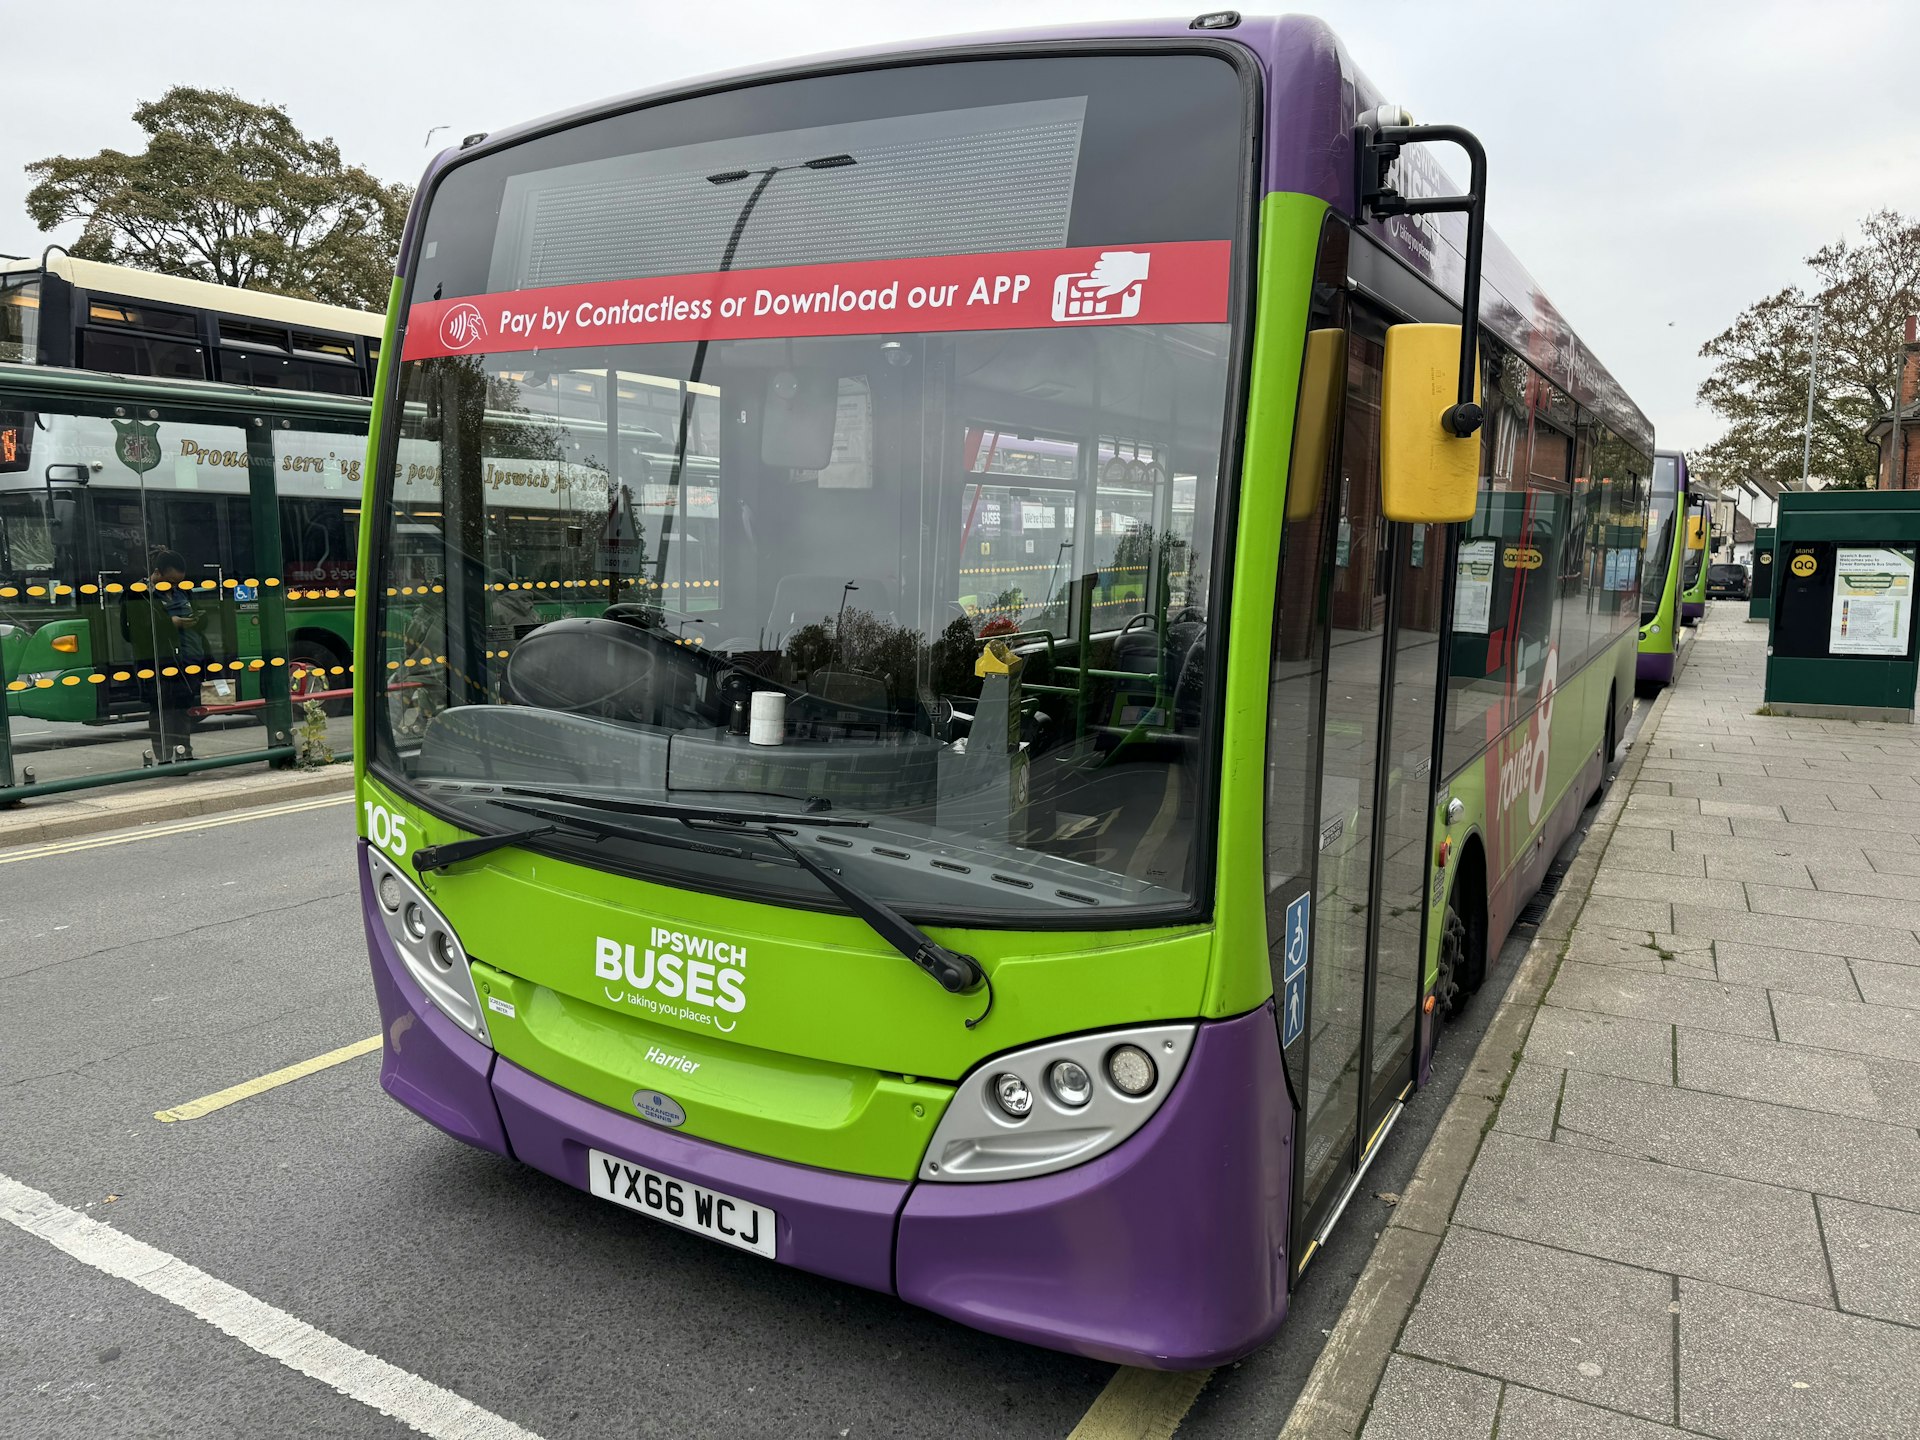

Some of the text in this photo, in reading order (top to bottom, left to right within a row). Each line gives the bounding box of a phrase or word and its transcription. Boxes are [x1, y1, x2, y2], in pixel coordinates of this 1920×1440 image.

[500, 274, 1031, 337] Pay by Contactless or Download our APP
[180, 438, 249, 469] Prou
[485, 463, 549, 490] Ipswich
[1794, 560, 1814, 570] QQ
[1496, 733, 1532, 821] route
[1528, 648, 1558, 826] 8
[364, 800, 407, 856] 105
[651, 927, 747, 968] IPSWICH
[595, 936, 747, 1014] BUSES
[627, 992, 711, 1024] taking you places
[644, 1046, 701, 1074] Harrier
[636, 1102, 680, 1120] ALEXANDER
[644, 1110, 672, 1123] DENNIS
[603, 1158, 759, 1244] YX66 WCJ
